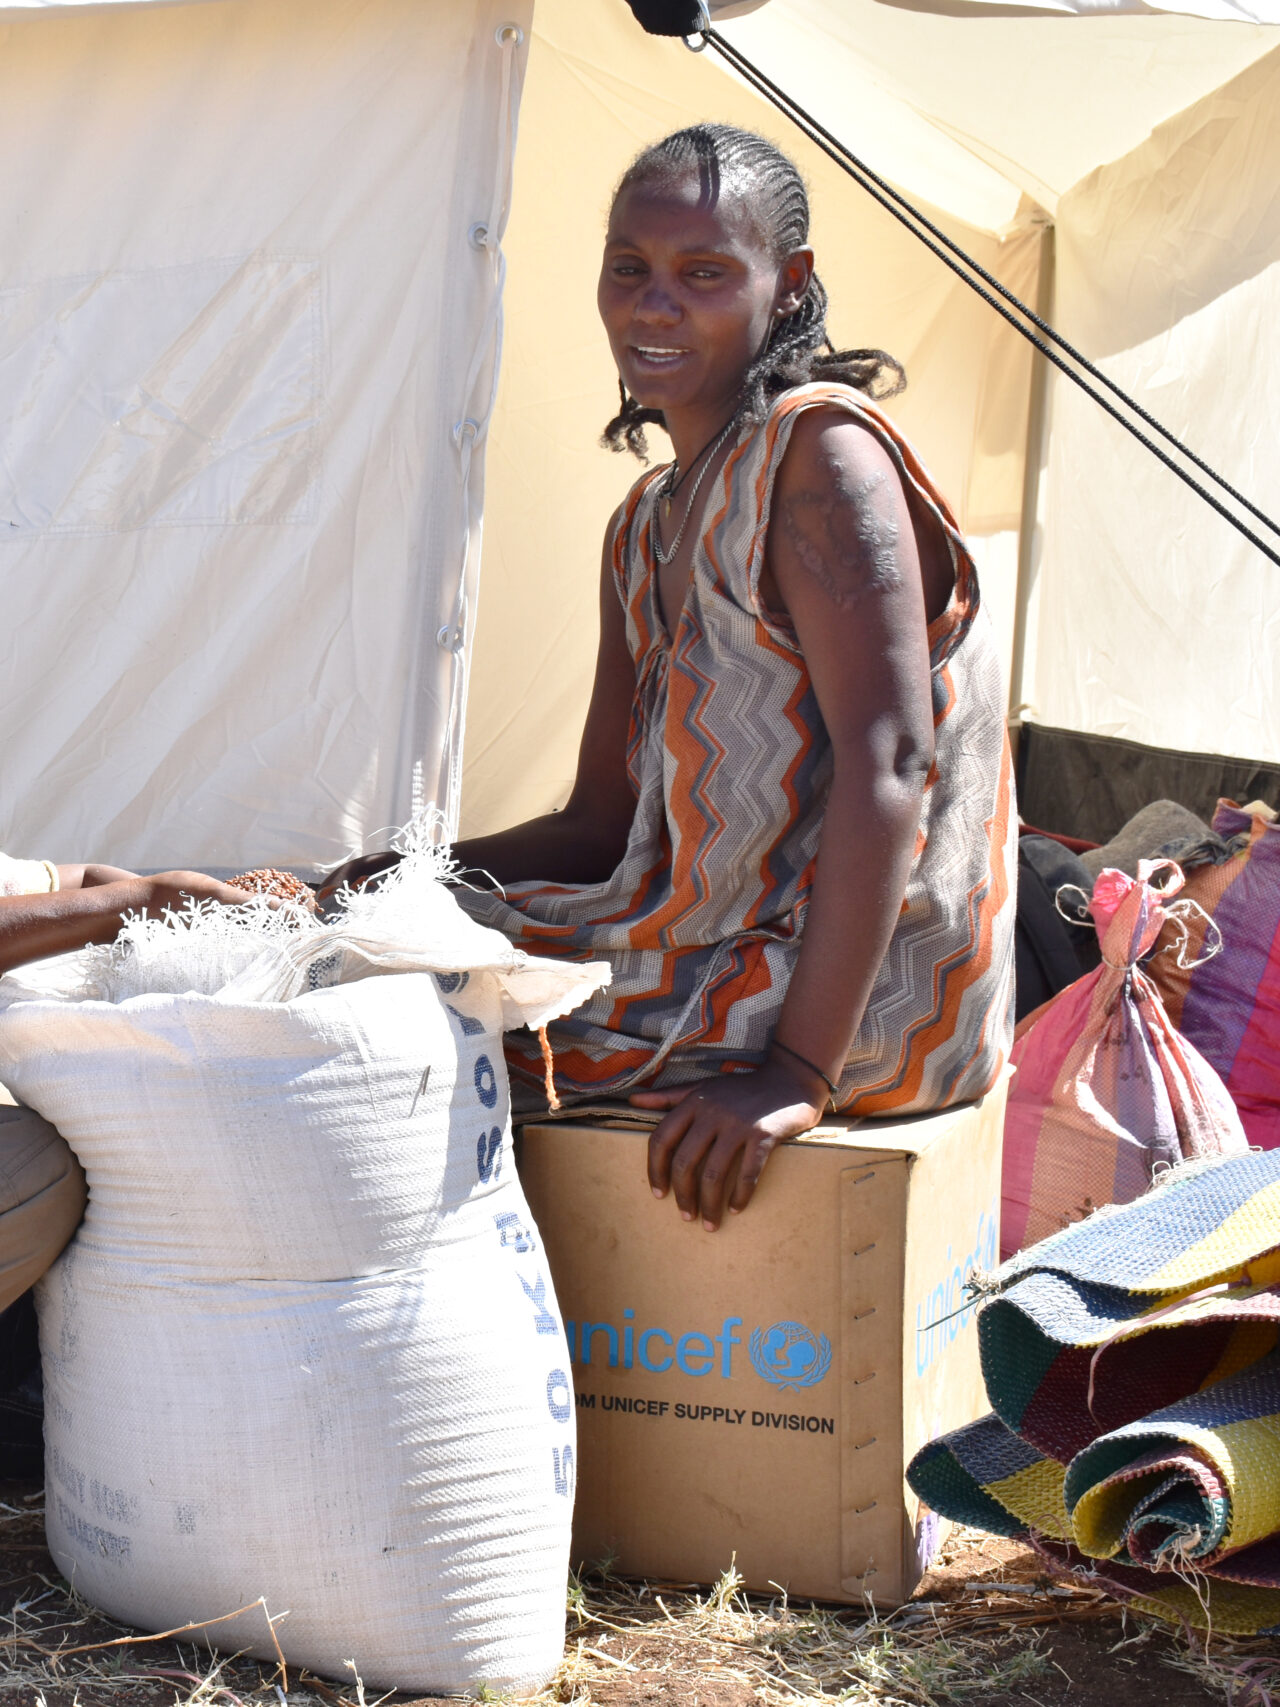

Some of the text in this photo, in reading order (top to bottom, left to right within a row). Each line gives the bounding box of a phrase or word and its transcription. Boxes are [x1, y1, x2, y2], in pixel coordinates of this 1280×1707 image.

[601, 1396, 669, 1416] UNICEF
[674, 1402, 746, 1425] SUPPLY
[751, 1411, 834, 1435] DIVISION
